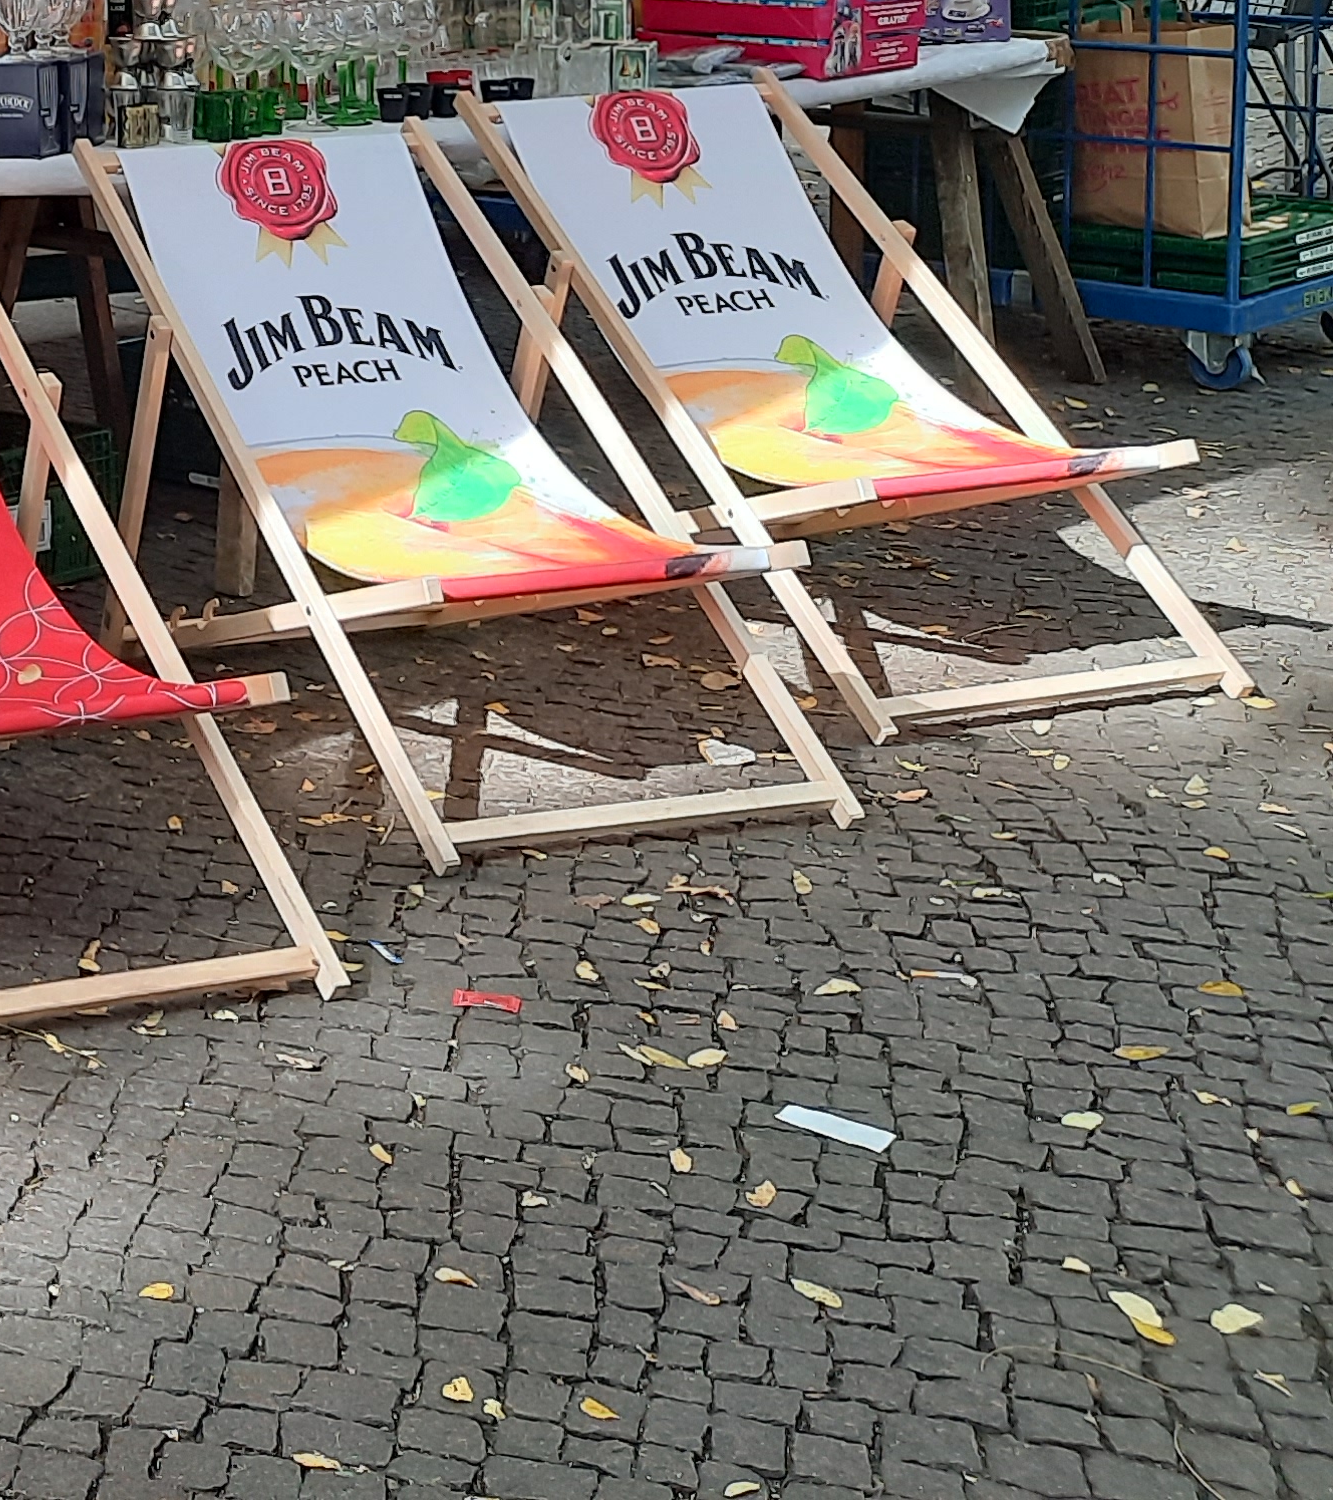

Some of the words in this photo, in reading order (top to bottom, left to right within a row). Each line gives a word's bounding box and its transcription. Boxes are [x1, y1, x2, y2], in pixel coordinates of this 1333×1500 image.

[626, 98, 668, 121] BEAM
[240, 152, 258, 175] JIM
[260, 148, 305, 173] BEAM
[614, 134, 657, 160] SINCE
[244, 186, 290, 216] SINCE
[606, 247, 686, 320] JIM
[670, 231, 828, 302] BEAM
[674, 288, 776, 317] PEACH
[221, 315, 307, 391] JIM
[294, 294, 462, 373] BEAM
[291, 358, 402, 388] PEACH
